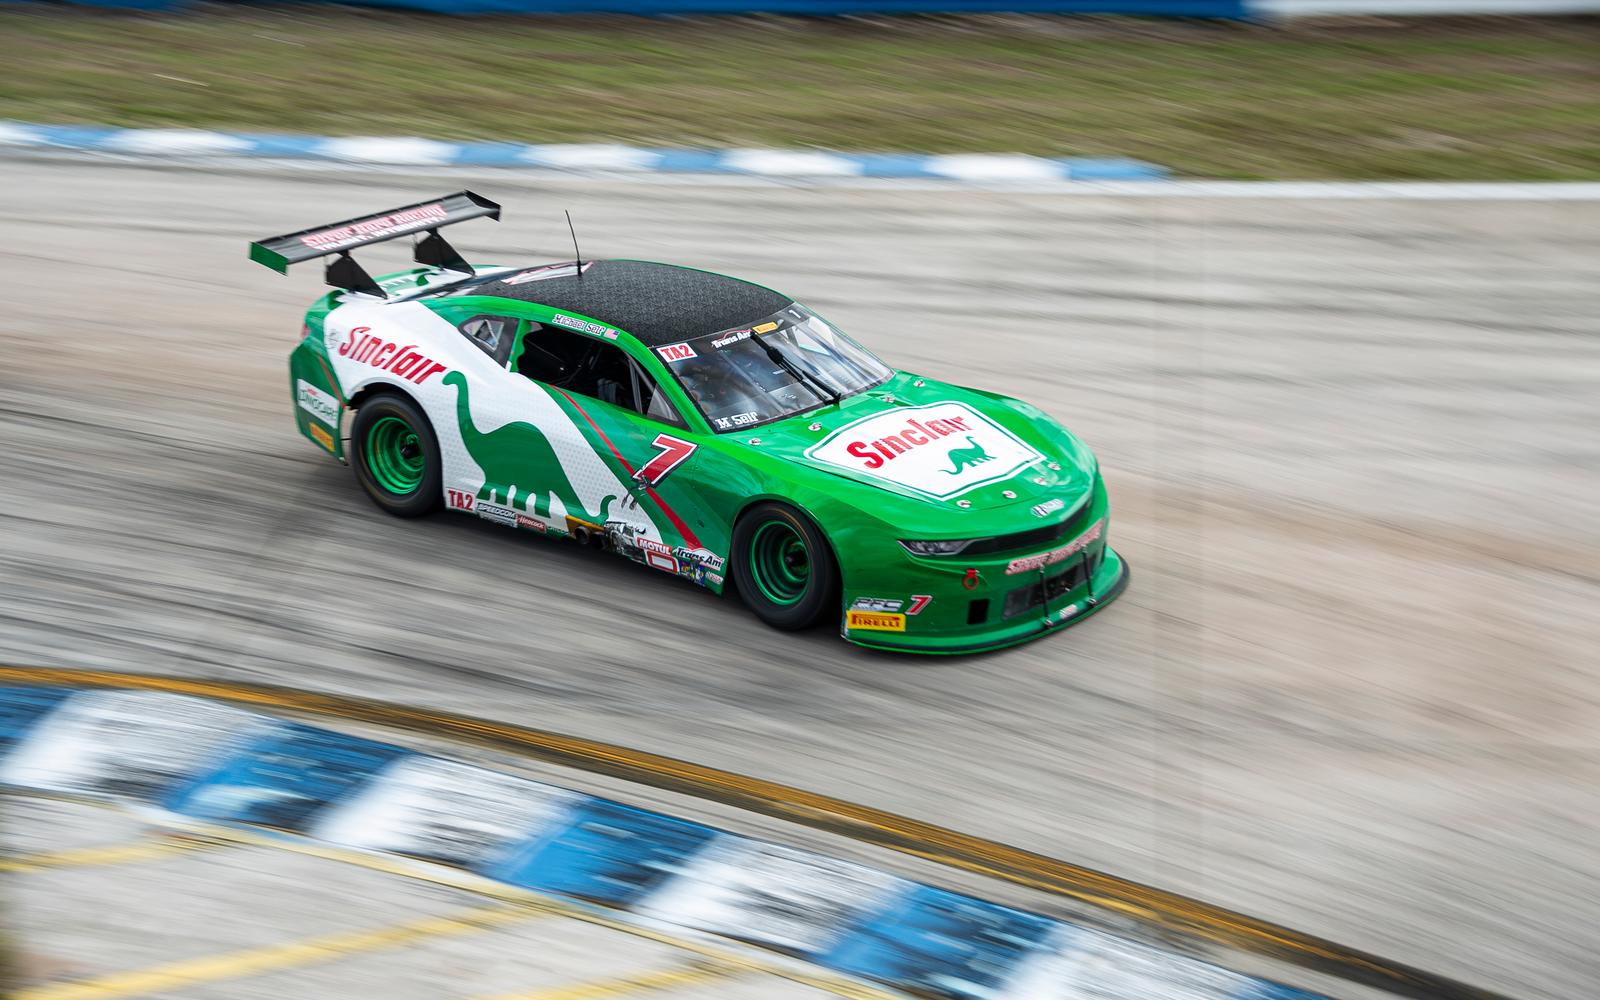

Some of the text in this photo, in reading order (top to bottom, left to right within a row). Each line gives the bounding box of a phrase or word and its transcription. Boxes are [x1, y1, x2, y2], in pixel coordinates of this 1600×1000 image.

[552, 313, 605, 336] Michael Self
[712, 333, 739, 349] Trans
[338, 326, 447, 384] Sinclair
[661, 344, 694, 360] TA2
[715, 411, 758, 430] M Self
[846, 415, 975, 470] Sinclair
[632, 433, 698, 486] 7
[447, 490, 473, 511] TA2
[639, 539, 672, 556] MOTUL
[675, 547, 722, 569] Trans Am
[905, 594, 933, 616] 7
[852, 613, 901, 628] PIRELLI
